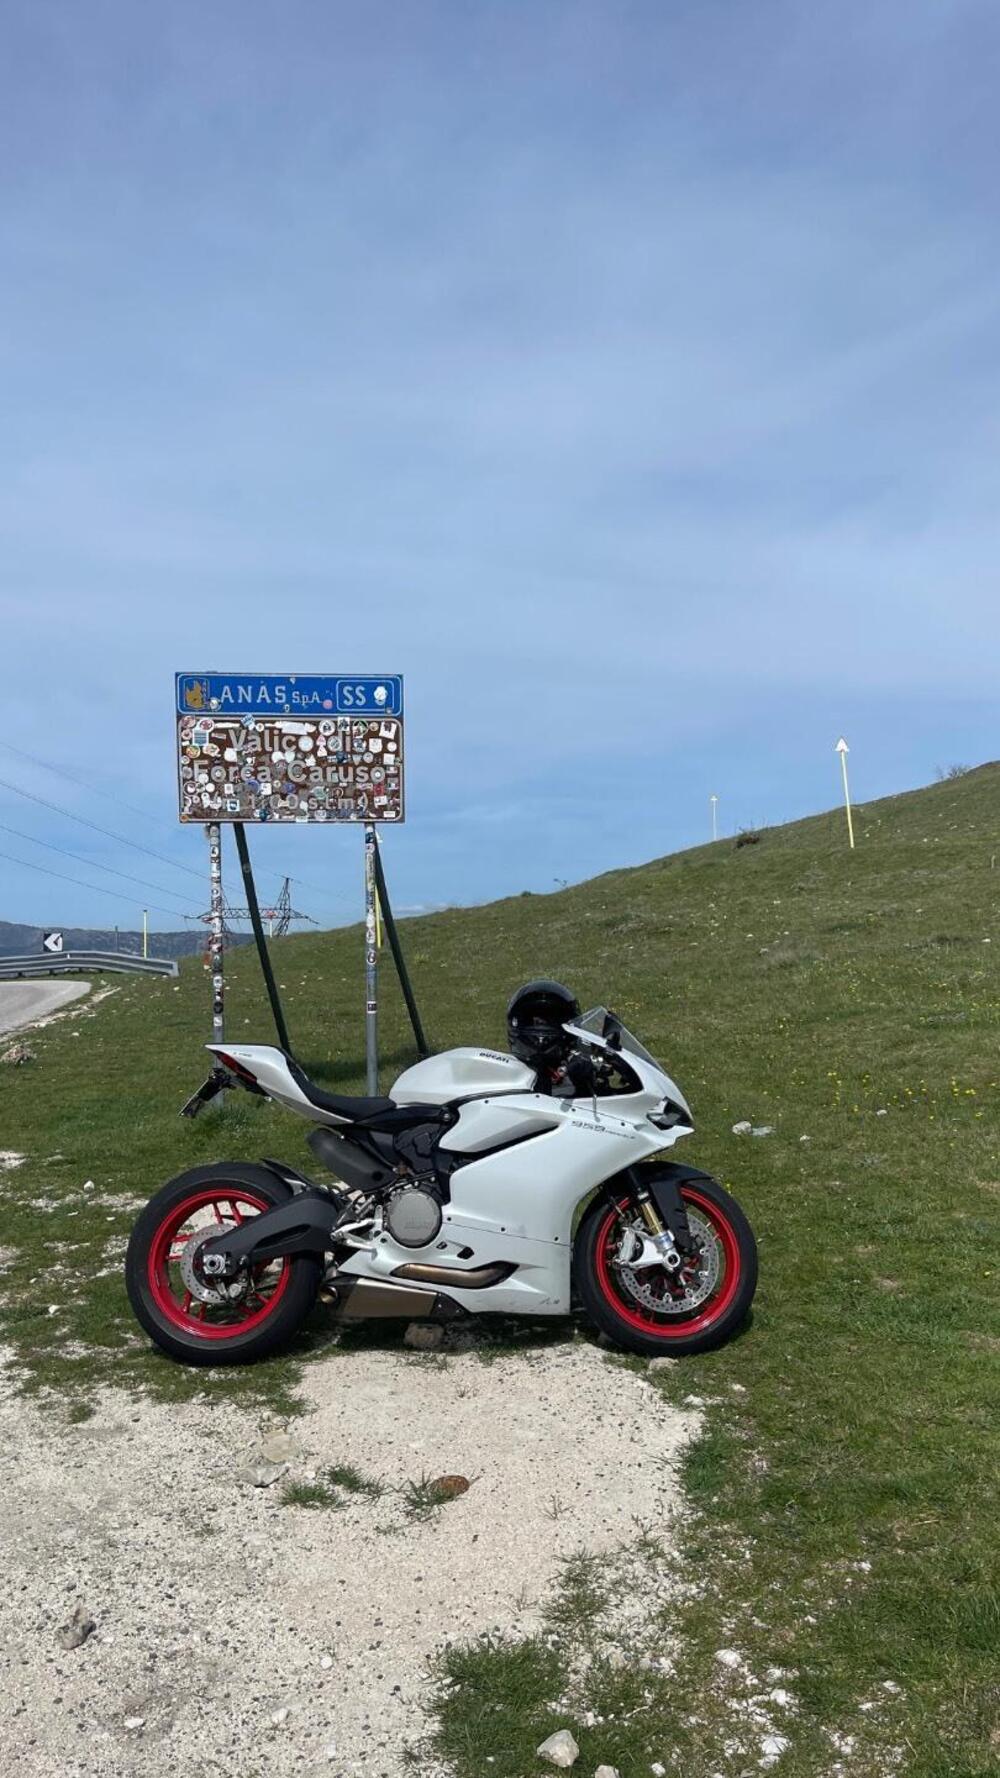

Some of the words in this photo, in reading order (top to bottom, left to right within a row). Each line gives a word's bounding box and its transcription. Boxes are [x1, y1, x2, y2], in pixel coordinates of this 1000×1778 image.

[220, 685, 286, 704] ANAS
[343, 685, 366, 706] SS
[228, 729, 314, 752] Valic
[194, 760, 272, 783] Forca
[287, 760, 386, 784] Caruso
